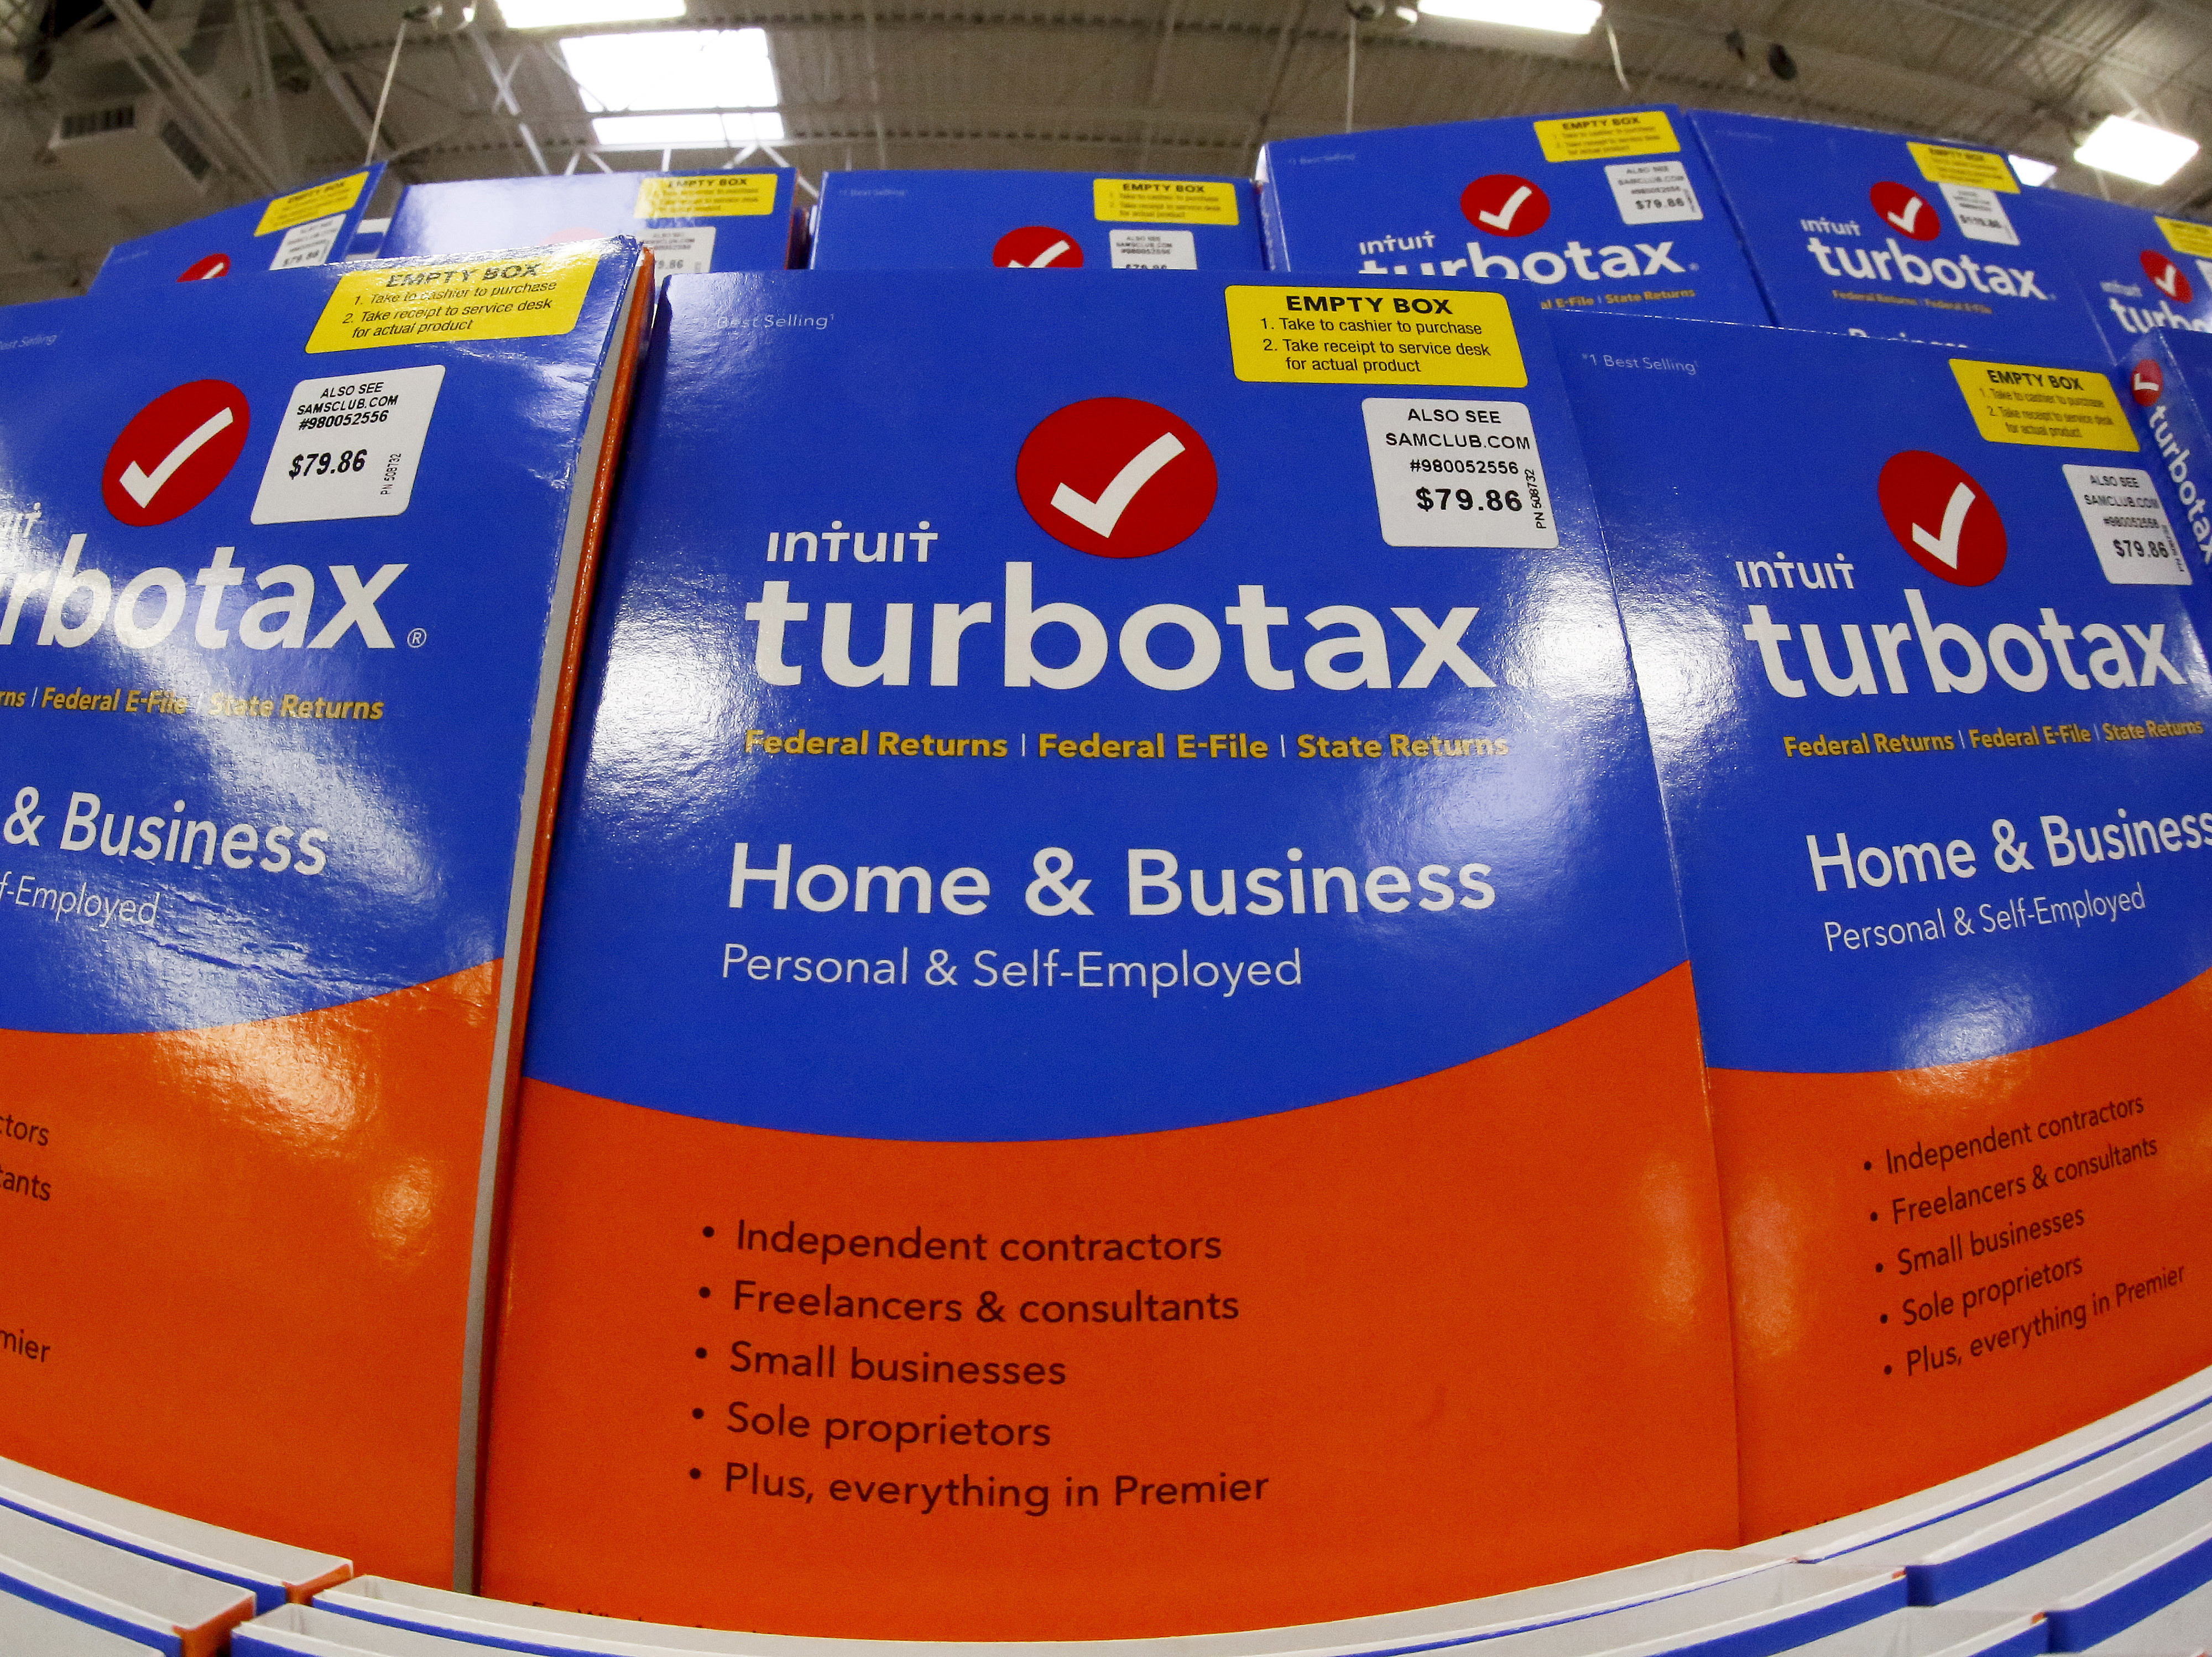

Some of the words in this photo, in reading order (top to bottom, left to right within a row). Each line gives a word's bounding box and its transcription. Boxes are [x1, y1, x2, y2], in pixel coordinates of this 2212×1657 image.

[1562, 118, 1607, 130] EMPTY
[1611, 116, 1641, 126] BOX
[1123, 183, 1170, 192] EMPTY
[1176, 184, 1205, 194] BOX
[1358, 230, 1436, 255] intuit
[387, 268, 478, 288] EMPTY
[482, 263, 542, 281] BOX
[355, 295, 363, 305] 1.
[474, 287, 487, 297] to
[491, 281, 557, 298] purchase
[1286, 295, 1383, 313] EMPTY
[1394, 297, 1453, 315] BOX
[343, 313, 353, 323] 2.
[362, 310, 390, 322] Take
[393, 306, 441, 321] receipt
[445, 305, 458, 316] to
[462, 302, 513, 315] service
[518, 299, 552, 311] desk
[352, 326, 371, 338] for
[374, 322, 415, 336] actual
[417, 320, 474, 335] product
[1261, 318, 1274, 330] 1.
[1279, 318, 1315, 331] Take
[1320, 319, 1334, 331] to
[1339, 319, 1394, 333] cashier
[1397, 321, 1411, 333] to
[1416, 322, 1482, 335] purchase
[1263, 338, 1277, 351] 2.
[1282, 339, 1319, 352] Take
[1324, 340, 1375, 355] receipt
[1380, 341, 1394, 354] to
[1399, 342, 1451, 355] service
[1456, 343, 1491, 357] desk
[1603, 354, 1639, 368] Best
[1286, 357, 1307, 370] for
[1312, 358, 1358, 372] actual
[1363, 358, 1422, 374] product
[1987, 369, 2044, 387] EMPTY
[2048, 375, 2084, 391] BOX
[297, 395, 399, 415] SAMSCLUB.COM
[321, 385, 354, 399] ALSO
[358, 381, 384, 394] SEE
[299, 410, 389, 431] #980052556
[1408, 409, 1459, 422] ALSO
[1465, 410, 1501, 424] SEE
[1385, 432, 1530, 450] SAMCLUB.COM
[289, 449, 367, 480] $79.86
[1410, 459, 1519, 474] #980052556
[1525, 469, 1542, 509] 508732
[2090, 474, 2118, 487] ALSO
[2119, 477, 2140, 488] SEE
[1416, 487, 1522, 511] $79.86
[1533, 511, 1547, 529] PN
[766, 520, 938, 563] intuit
[2112, 539, 2169, 558] $79.86
[1735, 551, 1855, 590] intuit
[744, 561, 1496, 690] turbotax
[1743, 588, 2188, 698] turbotax
[41, 686, 119, 711] Federal
[125, 688, 187, 714] E-File
[279, 694, 384, 720] Returns
[744, 729, 869, 756] Federal
[878, 731, 1008, 758] Returns
[1039, 733, 1164, 759] Federal
[1177, 734, 1269, 759] E-File
[1297, 734, 1382, 759] State
[1390, 734, 1509, 757] Returns
[1783, 734, 1871, 759] Federal
[1874, 731, 1955, 755] Returns
[1968, 725, 2040, 750] Federal
[2043, 724, 2092, 746] E-File
[2102, 722, 2146, 743] State
[2146, 719, 2204, 739] Returns
[4, 786, 45, 846] &
[60, 791, 329, 875] Business
[1806, 832, 1977, 892] Home
[1991, 818, 2036, 874] &
[2039, 808, 2212, 867] Business
[728, 842, 991, 916] Home
[1024, 846, 1095, 917] &
[1127, 847, 1496, 917] Business
[0, 870, 160, 928] f-Employed
[1824, 908, 1946, 952] Personal
[1953, 907, 1974, 937] &
[1979, 882, 2146, 934] Self-Employed
[722, 943, 909, 984] Personal
[925, 949, 958, 986] &
[973, 947, 1302, 998] Self-Employed
[1886, 1122, 2032, 1174] Independent
[2037, 1095, 2145, 1140] contractors
[1892, 1176, 2026, 1225] Freelancers
[2032, 1164, 2049, 1189] &
[2054, 1137, 2158, 1184] consultants
[737, 1219, 987, 1264] Independent
[1000, 1231, 1223, 1262] contractors
[1897, 1233, 1963, 1276] Small
[1970, 1208, 2085, 1257] businesses
[733, 1279, 963, 1322] Freelancers
[977, 1290, 1006, 1323] &
[1019, 1289, 1240, 1324] consultants
[1902, 1290, 1954, 1326] Sole
[1962, 1256, 2083, 1318] proprietors
[1906, 1345, 1962, 1377] Plus,
[1970, 1303, 2087, 1358] everything
[2093, 1292, 2110, 1316] in
[2115, 1264, 2185, 1308] Premier
[729, 1340, 836, 1378] Small
[849, 1346, 1067, 1386] businesses
[726, 1400, 811, 1438] Sole
[823, 1413, 1051, 1453] proprietors
[725, 1462, 815, 1504] Plus,
[828, 1473, 1050, 1517] everything
[1065, 1475, 1100, 1507] in
[1114, 1471, 1270, 1506] Premier
